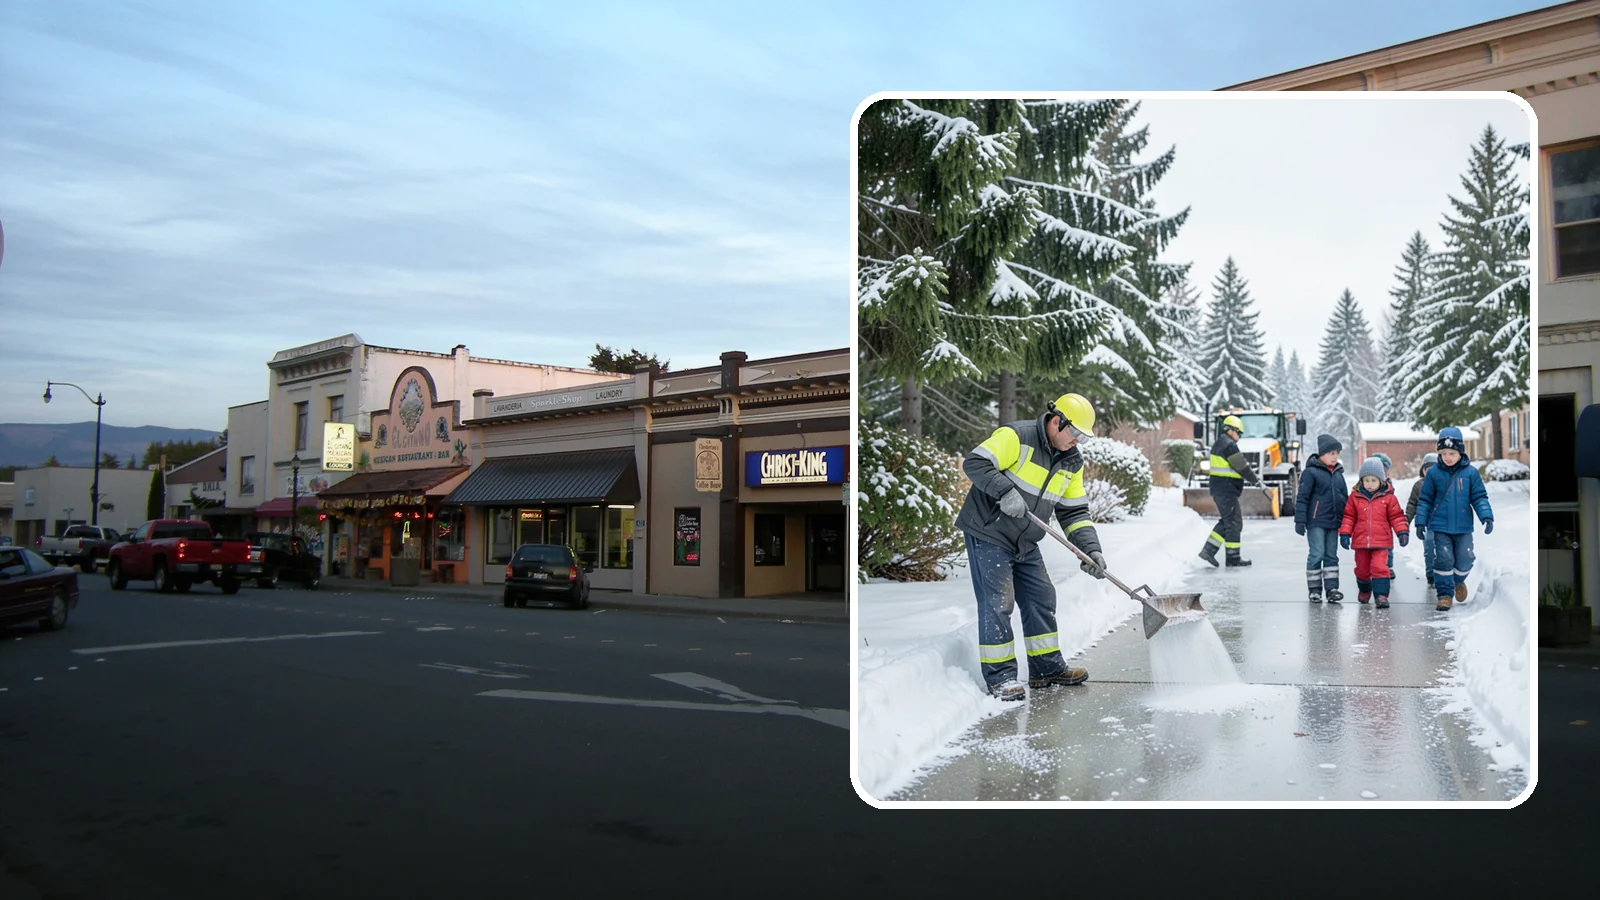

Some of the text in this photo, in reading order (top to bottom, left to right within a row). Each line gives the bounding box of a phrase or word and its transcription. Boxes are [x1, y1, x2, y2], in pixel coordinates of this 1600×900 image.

[595, 389, 624, 399] LAUNDRY
[494, 402, 523, 412] LAVANDERIA
[530, 394, 583, 409] Sparkle Shop
[373, 450, 450, 464] MEXICAN RESTAURANT BAR
[761, 450, 827, 477] CHRIST KING
